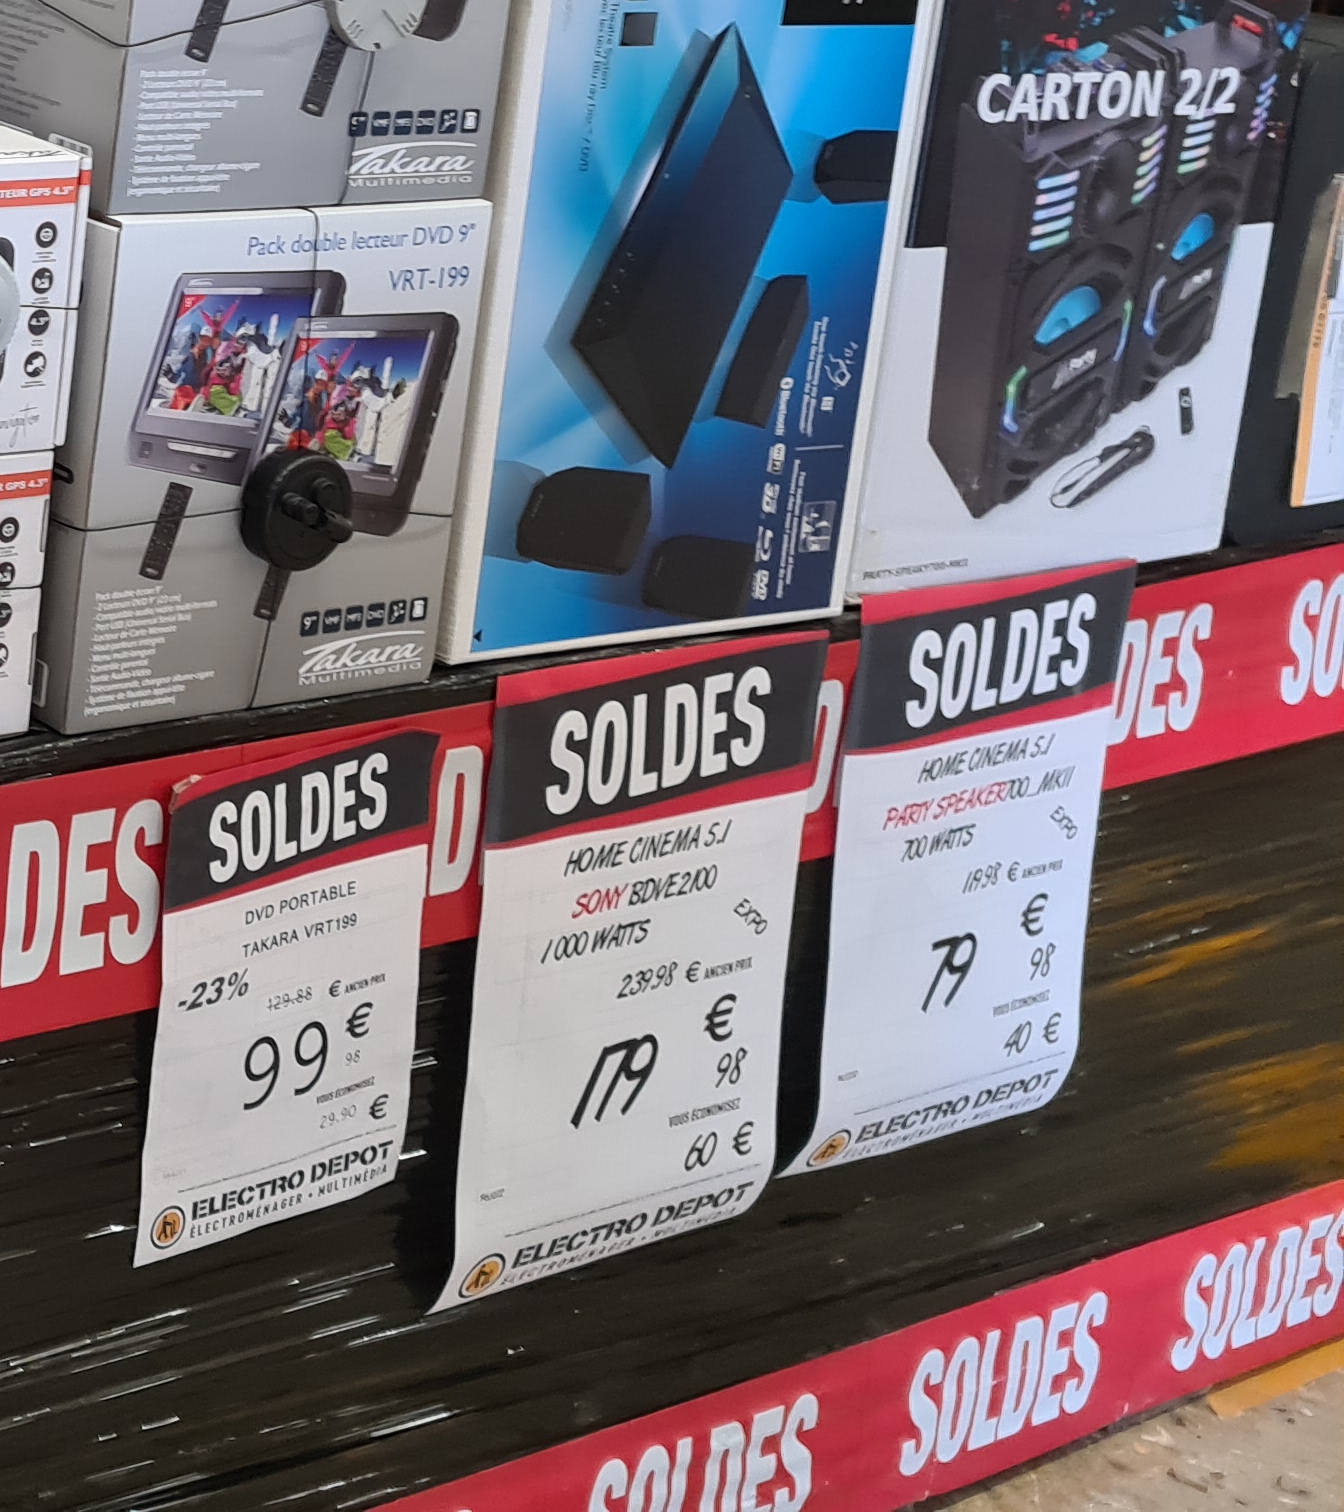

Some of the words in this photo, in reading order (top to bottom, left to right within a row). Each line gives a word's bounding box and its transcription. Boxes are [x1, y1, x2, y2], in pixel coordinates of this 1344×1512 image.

[976, 69, 1166, 123] CARTON
[1173, 66, 1241, 119] 2/2
[348, 174, 473, 188] Multimedia
[247, 236, 286, 257] Pack
[290, 232, 345, 255] double
[350, 229, 409, 252] lecteur
[411, 226, 454, 247] DVD
[387, 266, 471, 292] VRT-199
[5, 480, 26, 493] GPS
[298, 631, 425, 675] Takara
[298, 660, 423, 687] Multimedia
[905, 592, 1096, 728] SOLDES
[546, 665, 772, 816] SOLDES
[918, 751, 968, 784] HOME
[972, 737, 1031, 775] CINEMA
[208, 751, 390, 884] SOLDES
[883, 797, 930, 830] PARTY
[565, 842, 624, 877] HOME
[629, 824, 701, 865] CINEMA
[901, 838, 927, 862] 700
[929, 822, 977, 853] WATTS
[244, 905, 275, 926] DVD
[279, 881, 357, 913] PORTABLE
[572, 882, 627, 919] SONY
[628, 865, 718, 908] BDVE2100
[242, 929, 299, 958] TAKARA
[304, 913, 358, 939] VRT199
[734, 897, 769, 937] EXPO
[541, 930, 588, 965] 1000
[591, 919, 651, 954] WATTS
[1029, 942, 1057, 981] 98
[177, 968, 250, 1012] -23%
[922, 931, 977, 1013] 79
[243, 1020, 329, 1111] 99
[345, 1002, 374, 1039] €
[1003, 1020, 1032, 1057] 40
[855, 1093, 969, 1144] ELECTRO
[973, 1069, 1059, 1112] DEPOT
[684, 1131, 717, 1172] 60
[191, 1168, 305, 1221] ELECTRO
[310, 1140, 394, 1185] DEPOT
[511, 1213, 648, 1268] ELECTRO
[654, 1182, 754, 1230] DEPOT
[900, 1292, 1108, 1478] SOLDES
